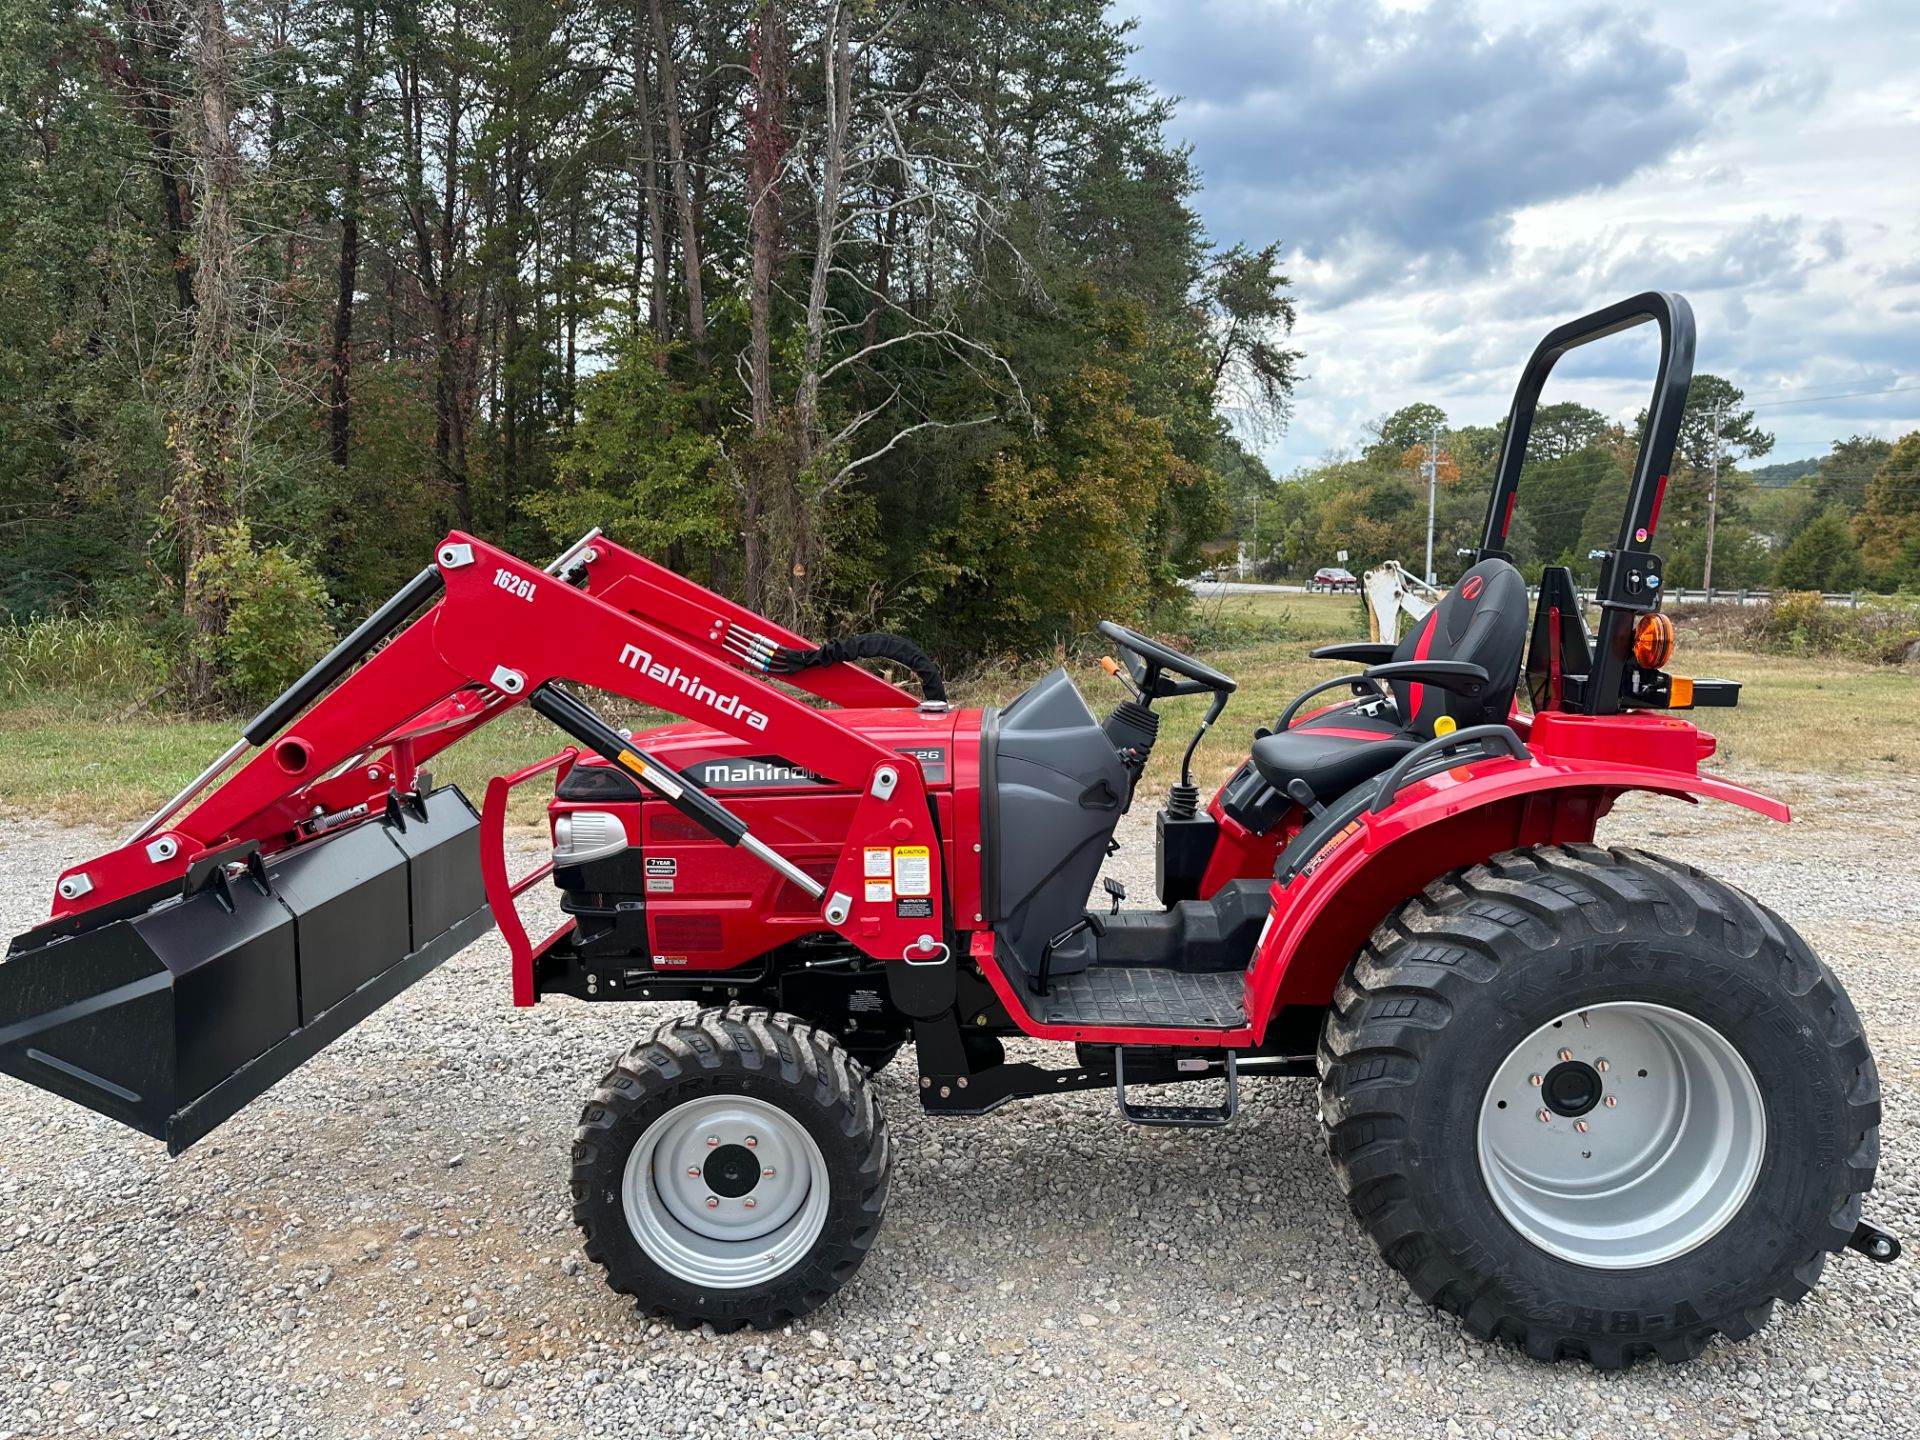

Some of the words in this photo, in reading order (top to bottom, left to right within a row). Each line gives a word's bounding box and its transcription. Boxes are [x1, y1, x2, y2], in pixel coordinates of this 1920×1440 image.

[492, 568, 537, 602] 1626L
[618, 643, 769, 732] Mahindra
[911, 751, 940, 760] 26
